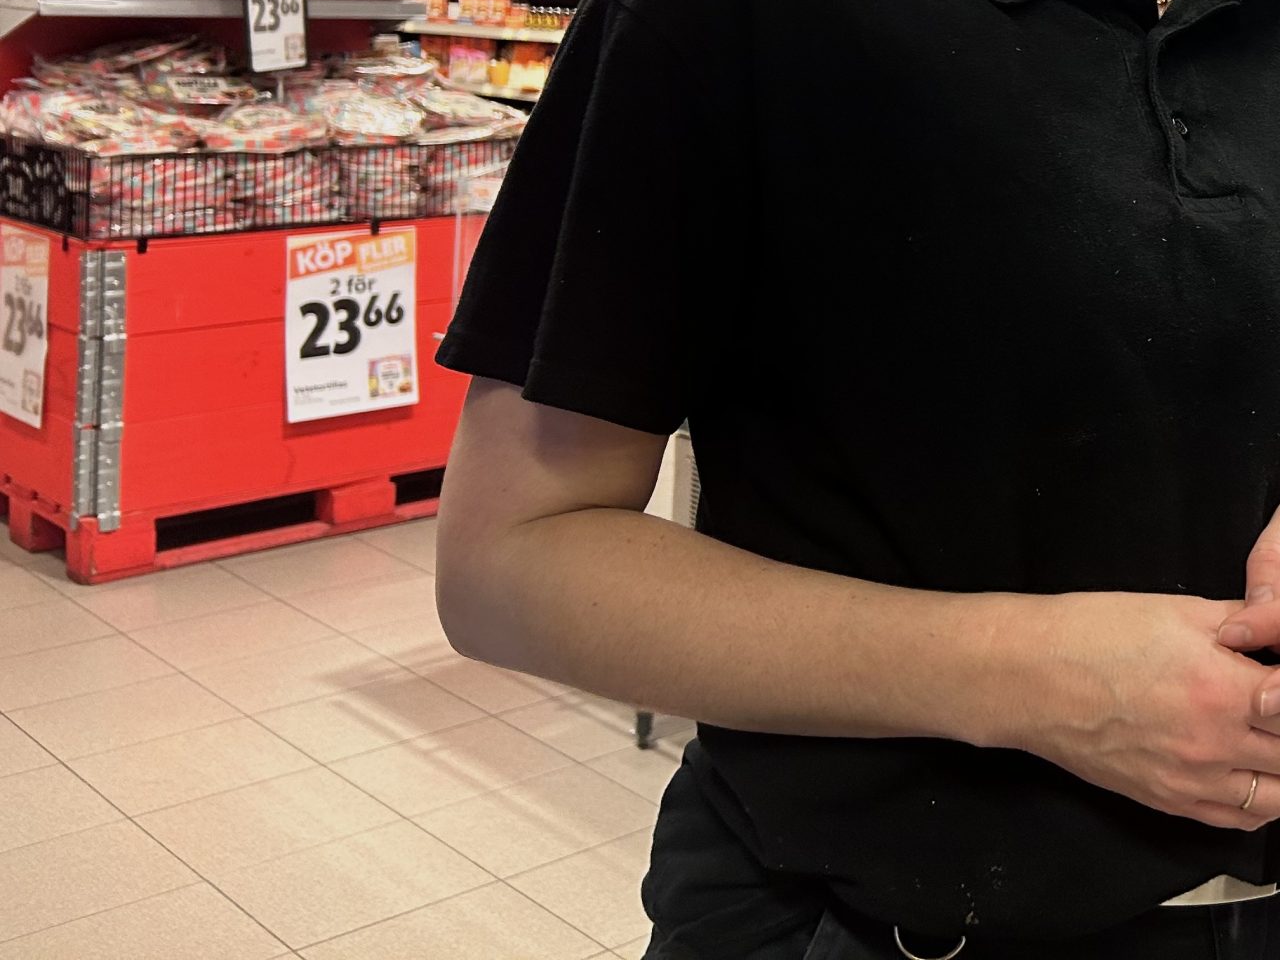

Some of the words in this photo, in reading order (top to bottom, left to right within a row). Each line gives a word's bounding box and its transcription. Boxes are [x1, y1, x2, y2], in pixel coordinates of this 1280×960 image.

[296, 240, 352, 274] KÖP
[359, 235, 407, 262] FLER
[330, 279, 340, 295] 2
[348, 275, 377, 294] för
[299, 290, 405, 359] 2366
